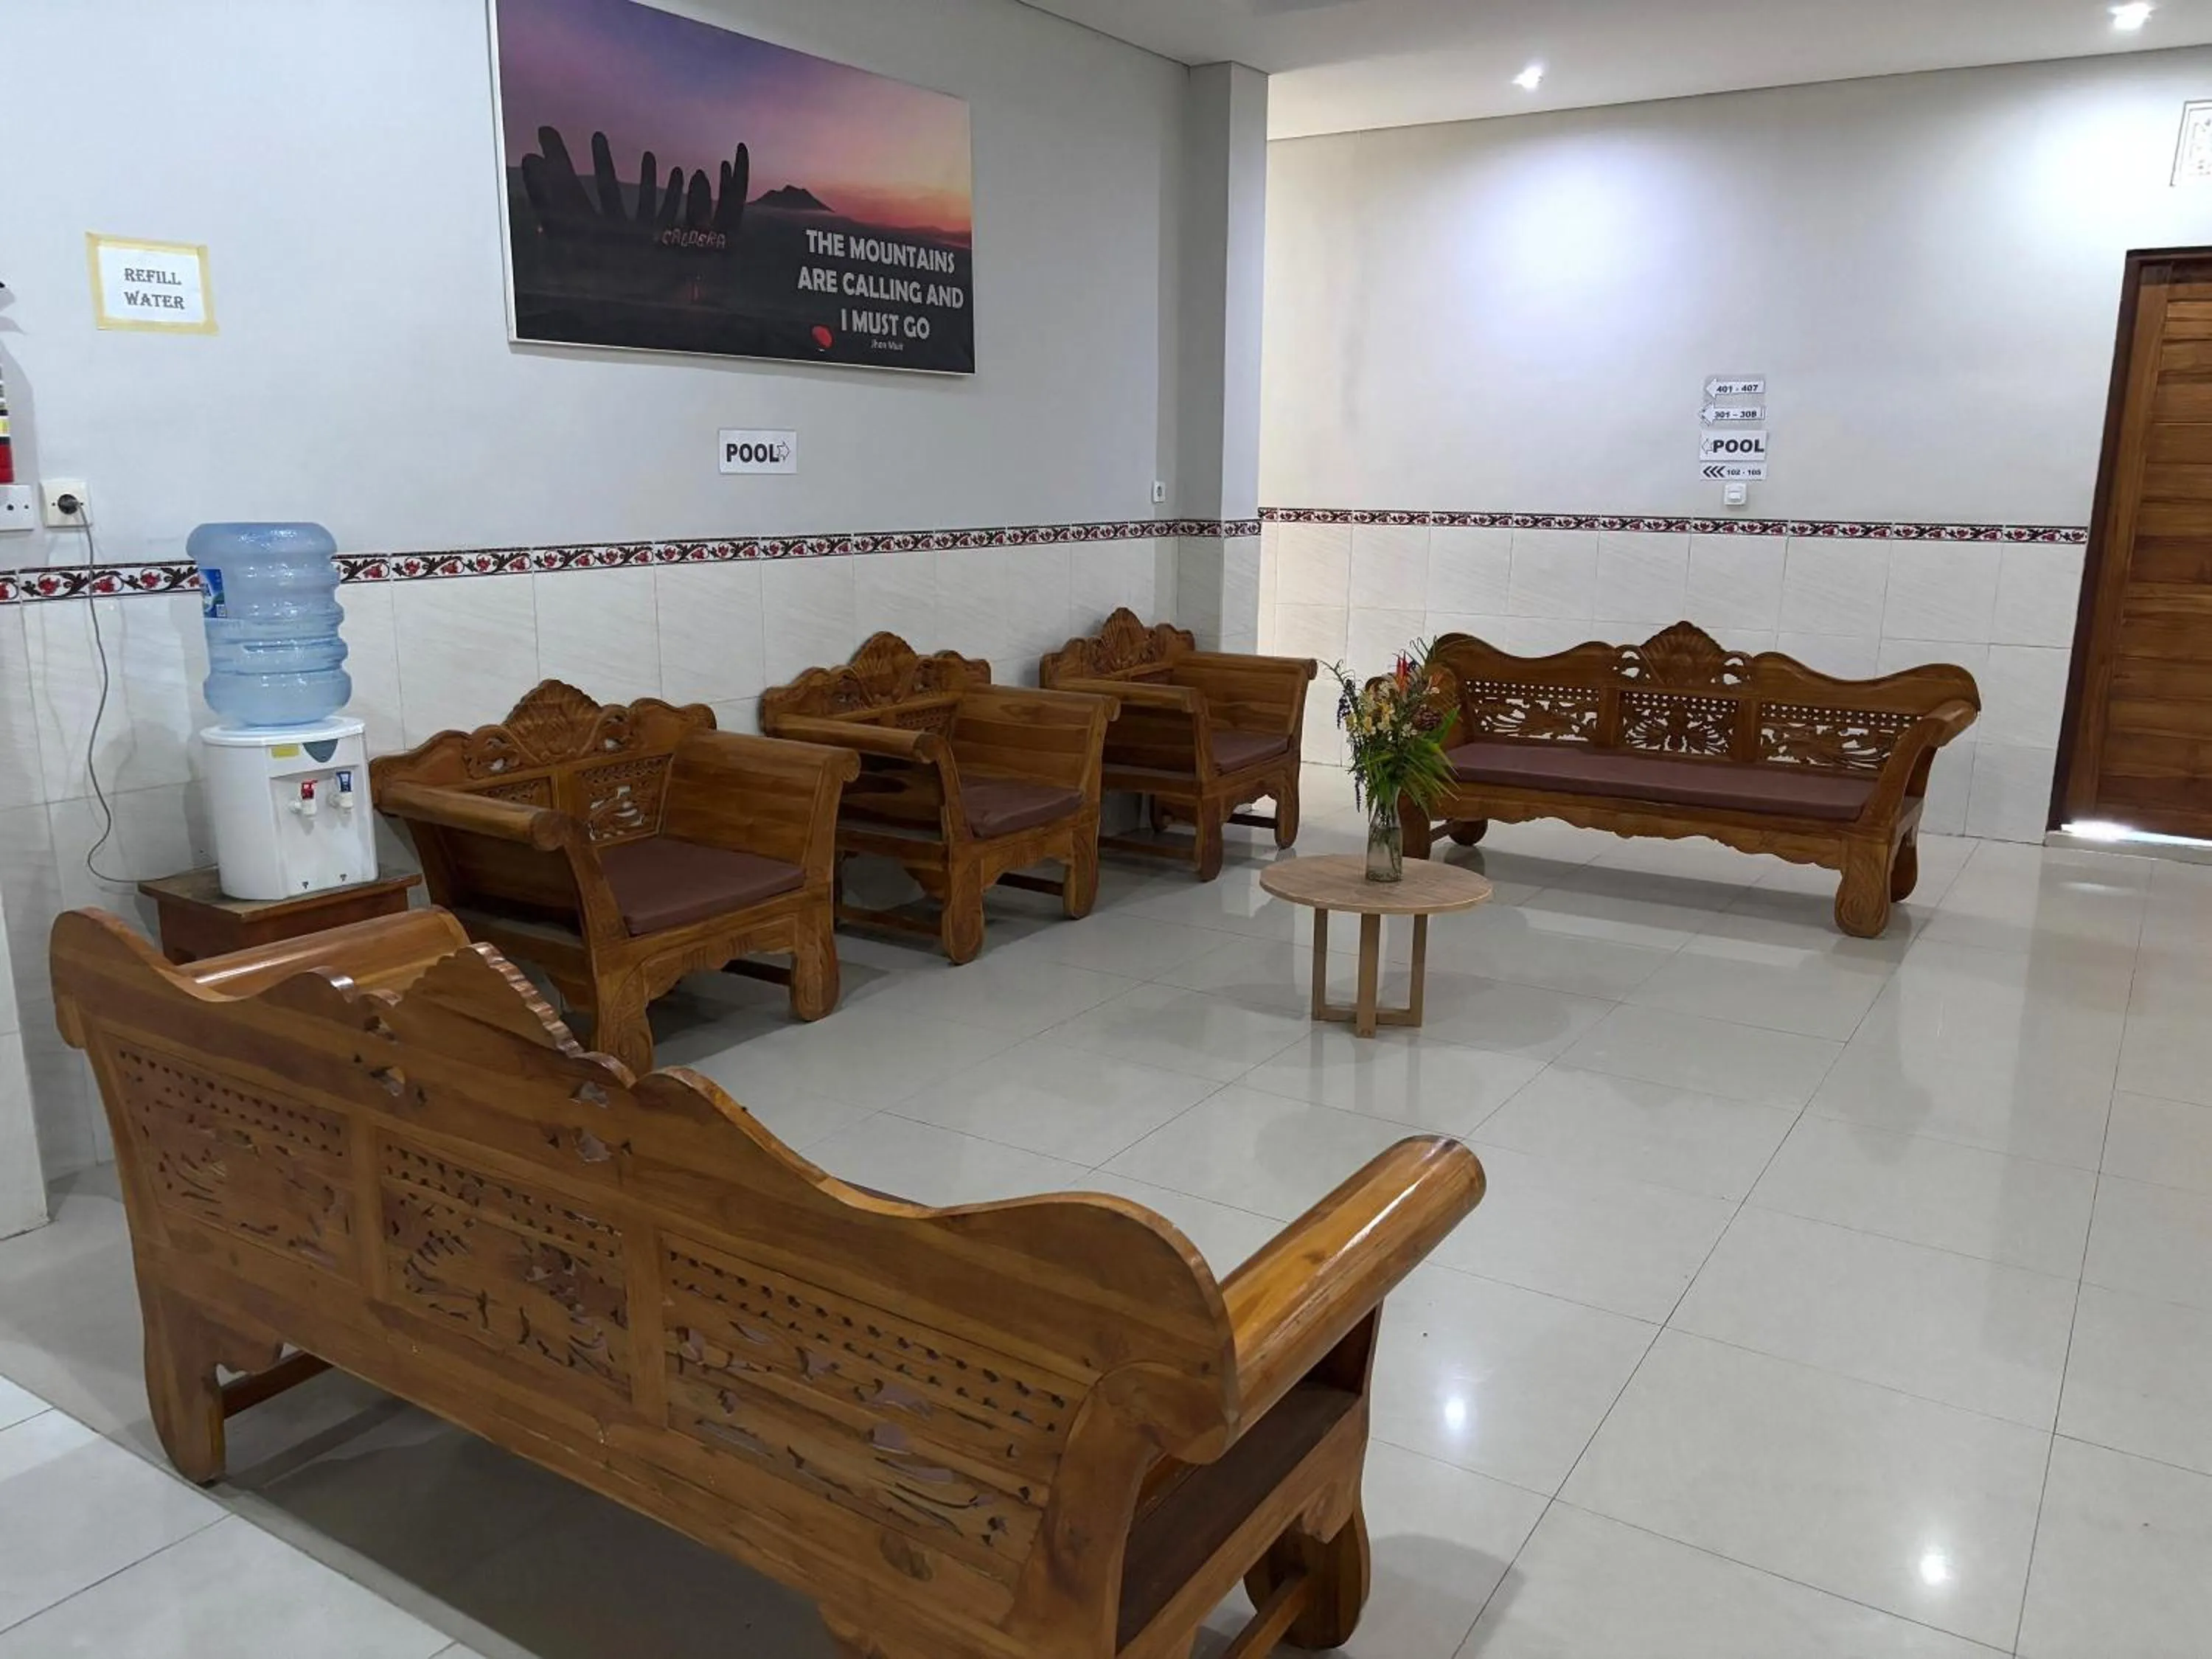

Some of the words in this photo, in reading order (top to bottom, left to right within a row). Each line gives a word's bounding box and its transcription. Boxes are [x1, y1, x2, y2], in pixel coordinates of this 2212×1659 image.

[806, 229, 845, 257] THE
[849, 236, 955, 274] MOUNTAINS
[124, 268, 181, 285] REFILL
[798, 266, 838, 293] ARE
[843, 272, 922, 303] CALLING
[926, 284, 964, 307] AND
[124, 291, 185, 310] WATER
[841, 308, 847, 331] I
[852, 310, 899, 336] MUST
[903, 316, 930, 340] GO
[1716, 386, 1733, 394] 401
[726, 443, 779, 463] POOL
[1713, 439, 1764, 453] POOL
